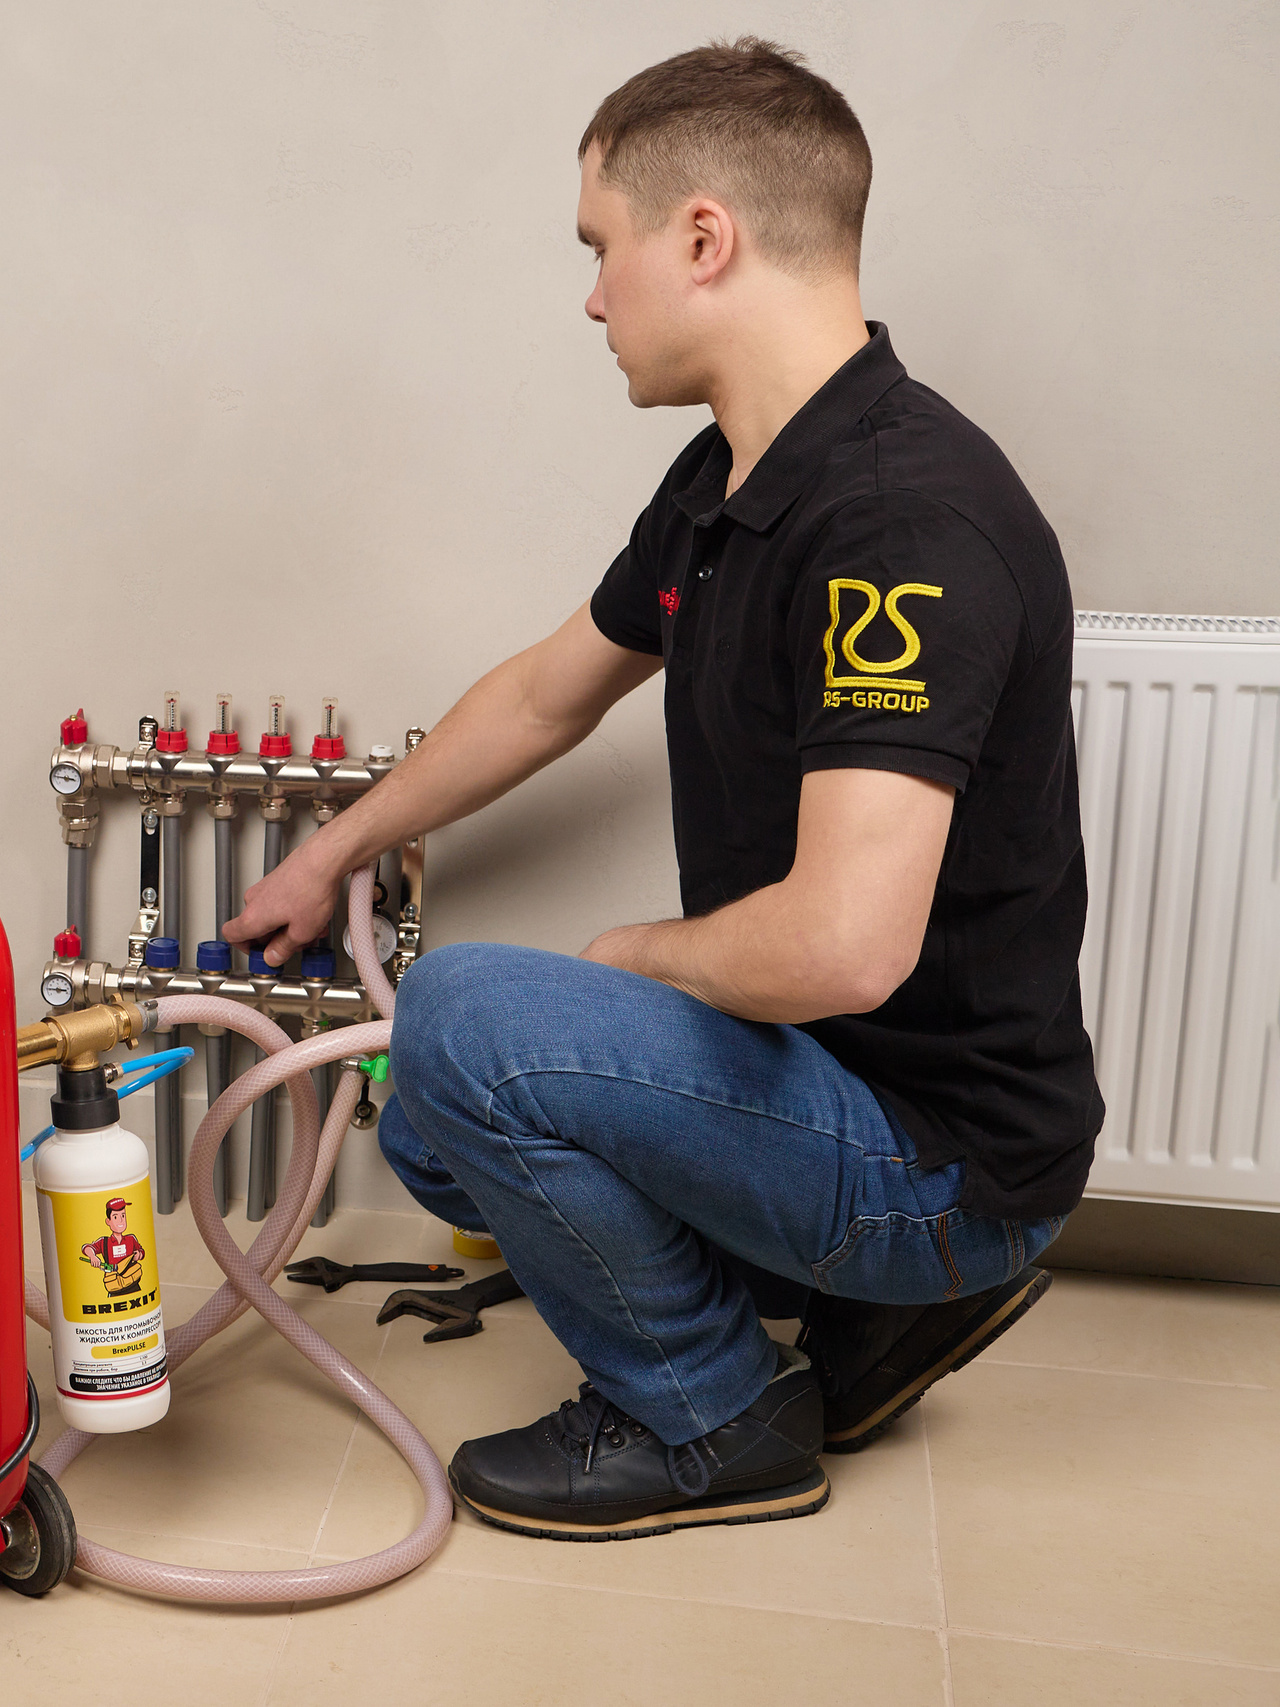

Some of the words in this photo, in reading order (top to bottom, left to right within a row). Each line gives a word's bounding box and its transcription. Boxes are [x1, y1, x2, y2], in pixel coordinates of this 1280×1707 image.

[823, 691, 930, 713] RS-GROUP
[82, 1290, 156, 1314] BREXIT
[108, 1326, 123, 1335] ДЛЯ
[79, 1335, 120, 1344] ЖИДКОСТИ
[112, 1342, 146, 1355] BrexPULSE
